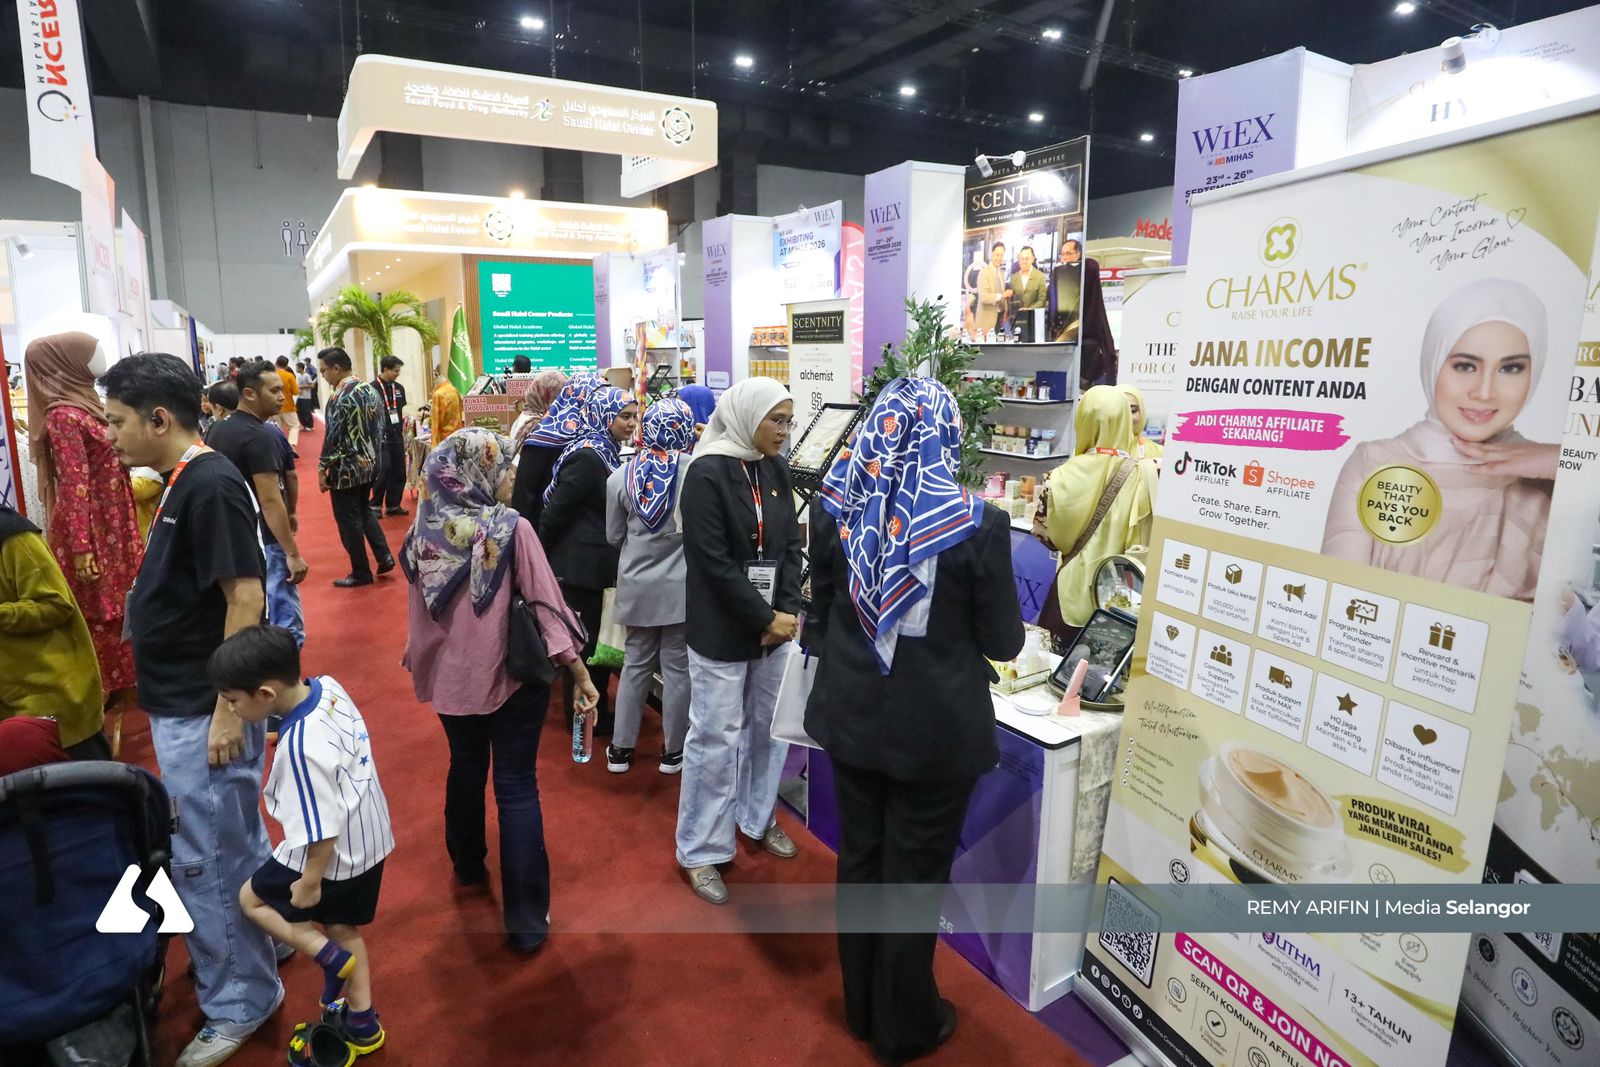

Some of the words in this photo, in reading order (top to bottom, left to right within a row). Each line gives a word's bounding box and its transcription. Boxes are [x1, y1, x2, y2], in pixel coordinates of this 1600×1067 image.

[432, 97, 456, 109] Food
[467, 102, 489, 115] Drug
[562, 115, 594, 129] Saudi
[594, 118, 622, 134] Halal
[623, 122, 656, 137] Center
[1038, 154, 1065, 166] EMPIRE
[1225, 151, 1255, 164] MIHAS
[1206, 174, 1225, 185] 23rd
[1233, 169, 1254, 180] 26th
[1392, 217, 1427, 239] Your
[1430, 193, 1487, 227] Content
[1135, 217, 1173, 241] Made
[1409, 232, 1446, 253] Your
[1450, 218, 1499, 242] Income
[780, 232, 814, 247] EXHIBITING
[780, 247, 787, 257] AT
[1429, 249, 1469, 271] Your
[1471, 235, 1515, 259] Glow
[1206, 263, 1358, 310] CHARMS
[793, 315, 843, 329] SCENTNITY
[1231, 310, 1256, 321] RAISE
[1257, 308, 1289, 320] YOUR
[1290, 306, 1314, 318] LIFE
[1188, 339, 1248, 368] JANA
[1254, 337, 1373, 369] INCOME
[800, 369, 834, 382] alchemist
[1131, 362, 1158, 374] FOR
[1186, 377, 1240, 395] DENGAN
[1242, 378, 1316, 397] CONTENT
[1316, 380, 1367, 401] ANDA
[1194, 415, 1217, 428] JADI
[1218, 414, 1264, 430] CHARMS
[1265, 416, 1325, 434] AFFILIATE
[1222, 427, 1284, 444] SEKARANG!
[1562, 448, 1598, 461] BEAUTY
[1194, 459, 1237, 479] TikTok
[1195, 475, 1230, 487] AFFILIATE
[1267, 471, 1316, 490] Shopee
[1377, 481, 1423, 496] BEAUTY
[1266, 486, 1311, 501] AFFILIATE
[1383, 491, 1414, 504] THAT
[1191, 493, 1222, 508] Create.
[1223, 499, 1252, 513] Share.
[1254, 506, 1281, 519] Earn.
[1366, 499, 1399, 516] PAYS
[1400, 504, 1430, 520] YOU
[1199, 507, 1223, 520] Grow
[1224, 512, 1270, 531] Together.
[1378, 512, 1414, 528] BACK
[1208, 582, 1227, 593] Produk
[1227, 588, 1239, 598] laku
[1225, 610, 1250, 623] setahun
[1234, 605, 1247, 614] unit
[1266, 600, 1278, 610] HQ
[1278, 602, 1303, 617] Support
[1266, 624, 1291, 639] dengan
[1291, 630, 1305, 641] Live
[1270, 617, 1288, 629] Kami
[1288, 622, 1308, 635] bantu
[1359, 626, 1391, 645] bersama
[1272, 633, 1292, 647] Spark
[1292, 639, 1301, 648] Ad
[1342, 632, 1372, 647] Founder
[1333, 648, 1357, 661] special
[1357, 656, 1383, 669] session
[1357, 646, 1385, 662] sharing
[1418, 648, 1451, 663] Reward
[1204, 662, 1236, 680] Community
[1401, 652, 1439, 668] incentive
[1439, 664, 1476, 681] menarik
[1197, 674, 1224, 690] Sokongan
[1207, 672, 1230, 685] Support
[1412, 675, 1456, 695] performer
[1414, 667, 1440, 679] untuk
[1441, 675, 1457, 686] top
[1201, 683, 1210, 691] HQ
[1255, 682, 1278, 696] Produk
[1278, 691, 1302, 707] support
[1261, 694, 1277, 705] CMV
[1277, 701, 1293, 711] MAX
[1265, 702, 1302, 724] mencukupi
[1330, 713, 1341, 723] HQ
[1341, 719, 1358, 732] jaga
[1315, 725, 1346, 744] Maintain
[1323, 720, 1340, 734] shop
[1340, 727, 1362, 743] rating
[1332, 743, 1347, 753] atas
[1384, 738, 1417, 757] Dibantu
[1417, 750, 1461, 775] influencer
[1384, 756, 1413, 775] Produk
[1415, 770, 1432, 782] dah
[1406, 757, 1441, 776] Selebriti
[1381, 764, 1402, 778] anda
[1403, 772, 1434, 796] tinggal
[1351, 798, 1396, 821] PRODUK
[1398, 813, 1432, 836] VIRAL
[1347, 809, 1371, 824] YANG
[1371, 816, 1424, 843] MEMBANTU
[1425, 837, 1454, 856] ANDA
[1358, 823, 1381, 839] JANA
[1382, 830, 1408, 848] LEBIH
[1410, 841, 1442, 863] SALES!
[1252, 849, 1298, 881] CHARMS
[938, 916, 954, 935] 26
[1276, 934, 1321, 977] UTHM
[1258, 943, 1281, 964] Research
[1281, 961, 1319, 993] Collaboration
[1283, 970, 1302, 987] UTHM
[1183, 940, 1223, 981] SCAN
[1226, 975, 1250, 1003] QR
[1252, 995, 1265, 1017] &
[1268, 1009, 1311, 1053] JOIN
[1190, 973, 1220, 1002] SERTAI
[1220, 994, 1268, 1043] KOMUNITI
[1344, 988, 1365, 1008] 13+
[1368, 1004, 1412, 1044] TAHUN
[1350, 1006, 1374, 1026] Dalam
[1373, 1023, 1399, 1045] Industri
[1355, 1017, 1392, 1048] Kecantikan
[1511, 1011, 1544, 1045] Brighter
